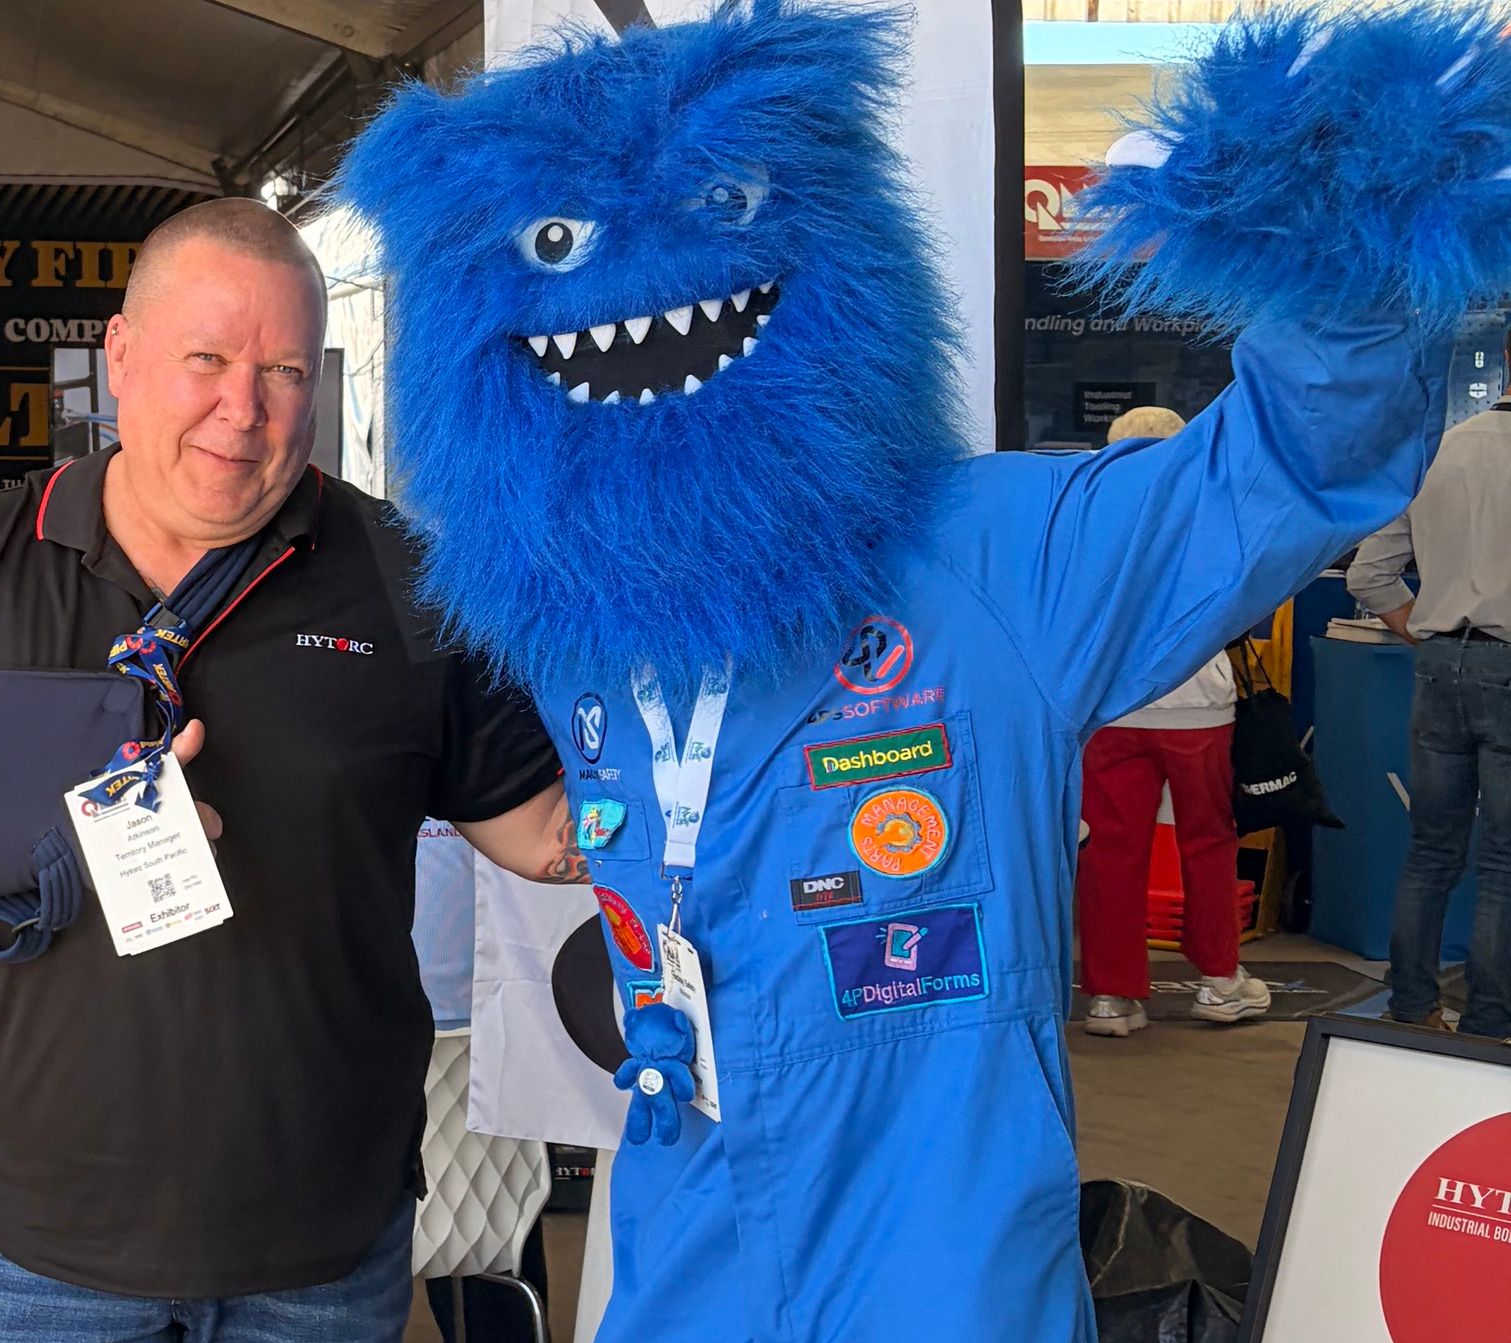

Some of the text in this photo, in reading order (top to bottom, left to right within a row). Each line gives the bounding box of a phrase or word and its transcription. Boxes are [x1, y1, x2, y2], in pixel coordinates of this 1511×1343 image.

[3, 318, 110, 344] COMP
[295, 632, 374, 656] HYTORC
[822, 740, 933, 773] Dashboard
[860, 796, 942, 861] MANAGEMENT
[861, 836, 902, 872] PARTS
[802, 876, 845, 894] DNC
[150, 902, 190, 924] Exhibitor
[1428, 1211, 1491, 1239] INDUSTRIAL
